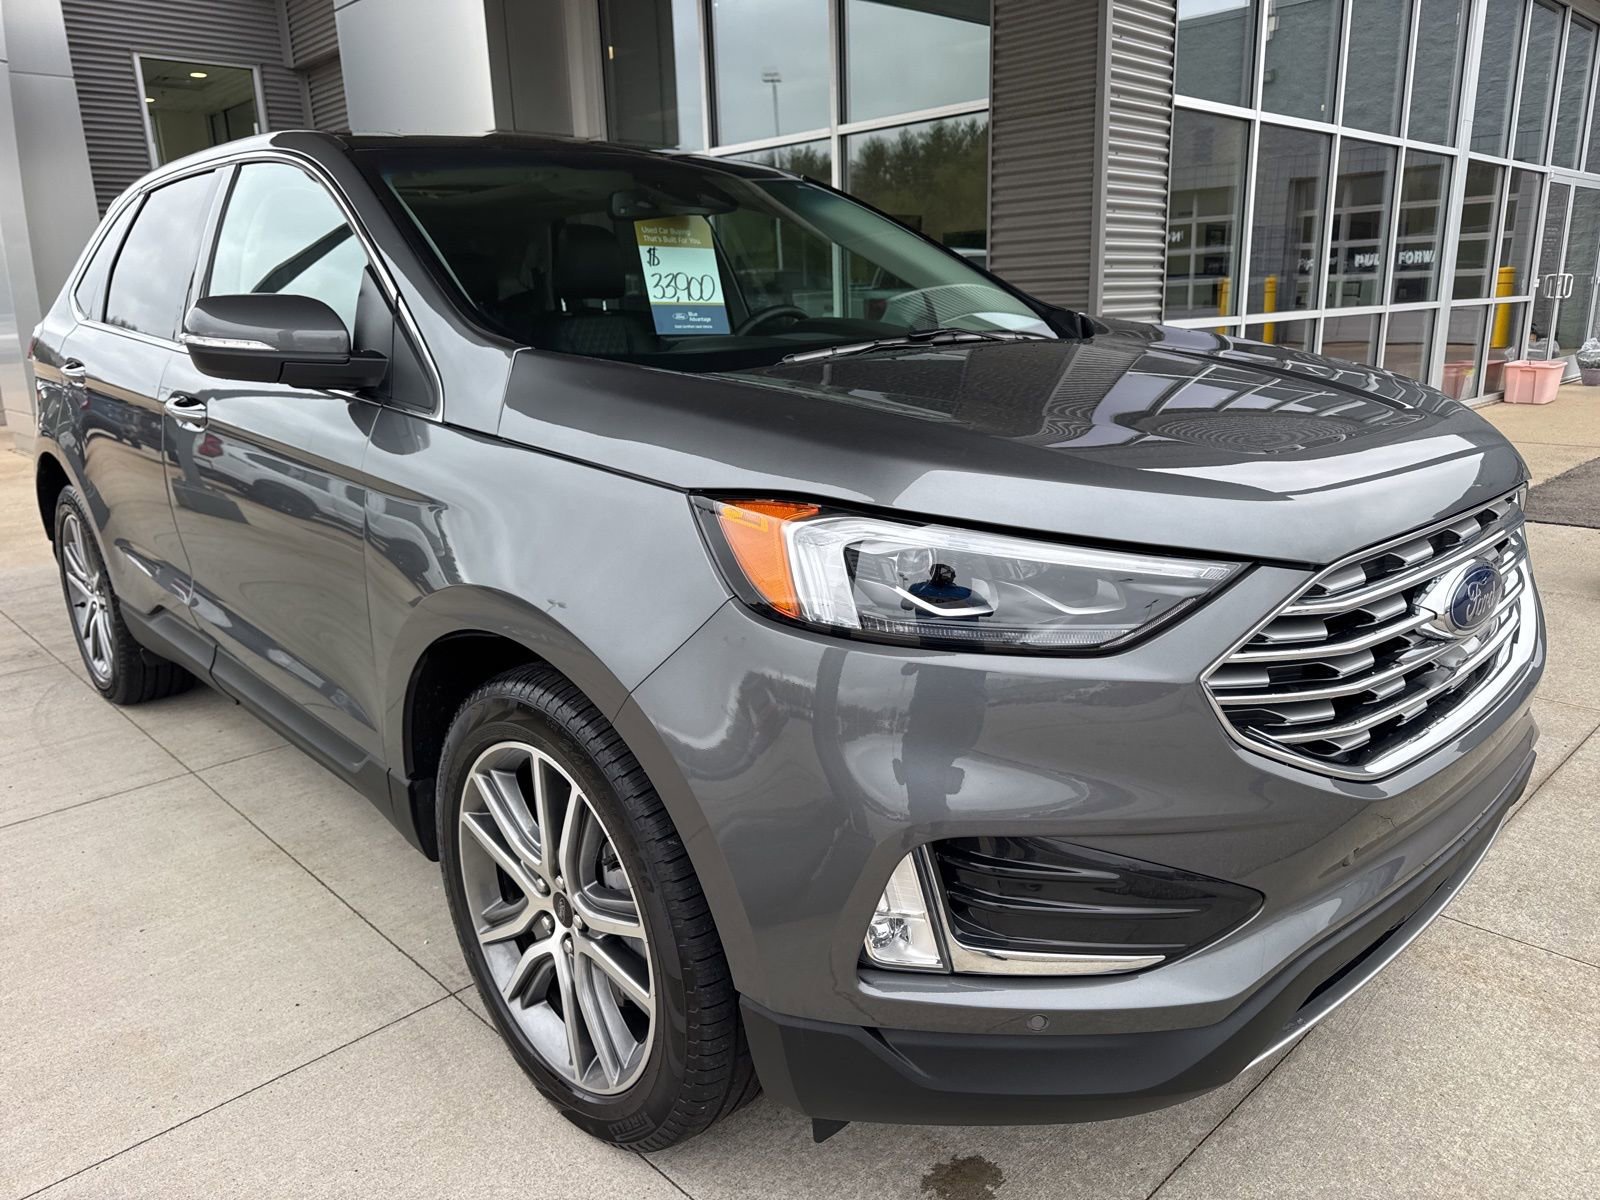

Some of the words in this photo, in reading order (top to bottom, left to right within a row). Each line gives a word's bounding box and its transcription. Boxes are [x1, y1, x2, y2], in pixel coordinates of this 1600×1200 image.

[641, 226, 657, 234] Used
[647, 246, 660, 267] $
[1354, 253, 1380, 267] PUL
[651, 272, 715, 302] 33,900
[1466, 577, 1496, 621] Ford
